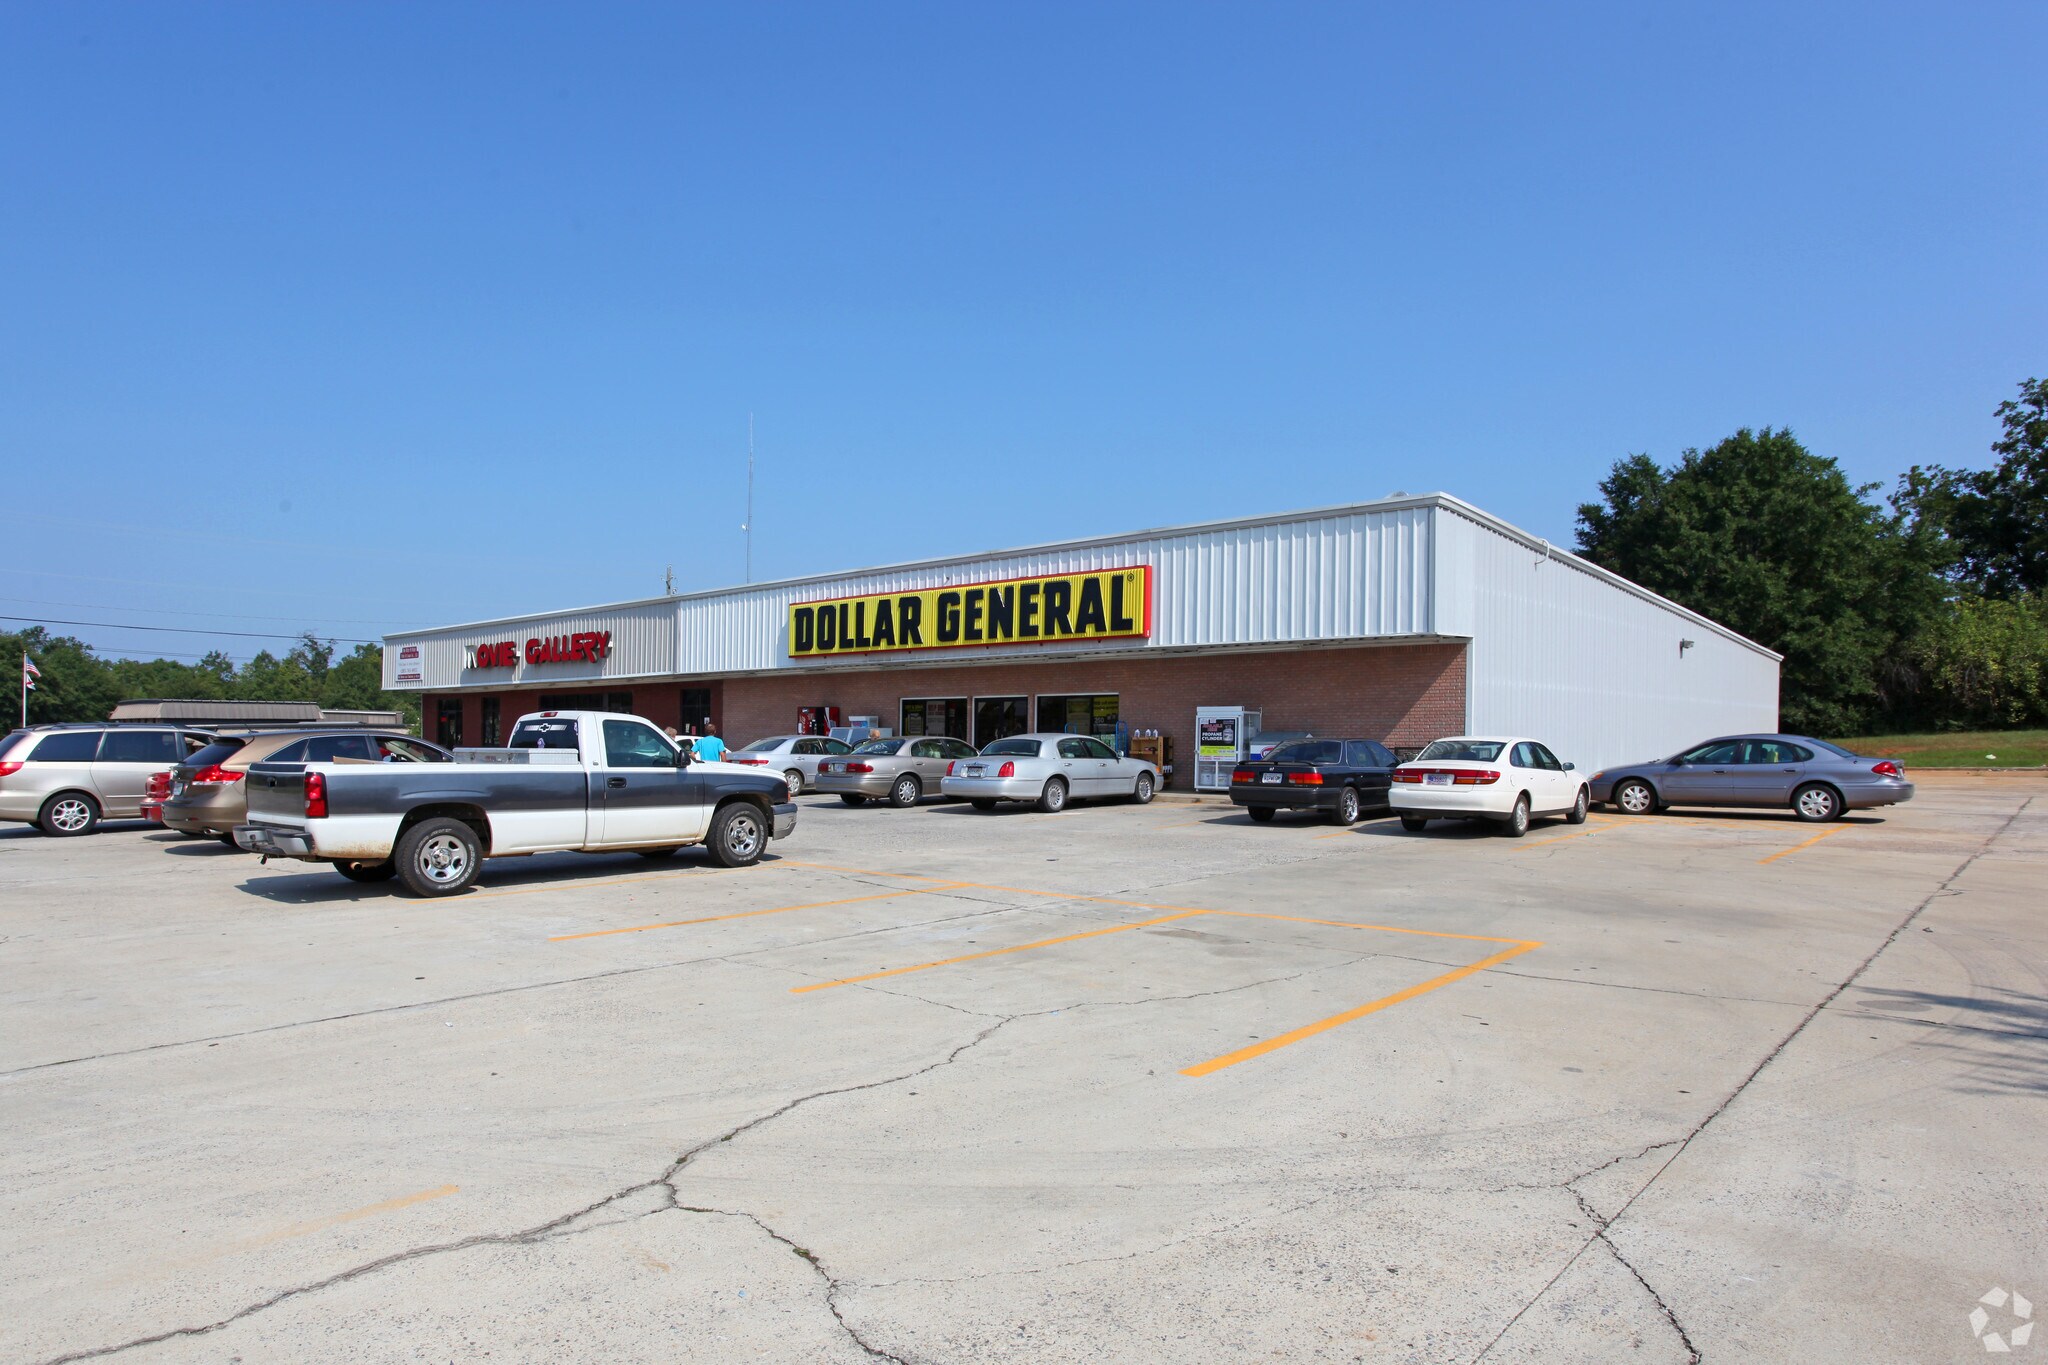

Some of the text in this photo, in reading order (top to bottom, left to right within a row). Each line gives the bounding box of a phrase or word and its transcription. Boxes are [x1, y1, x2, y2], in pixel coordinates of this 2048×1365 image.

[794, 574, 1134, 652] DOLLAR GENERAL
[525, 631, 610, 664] GALLERY
